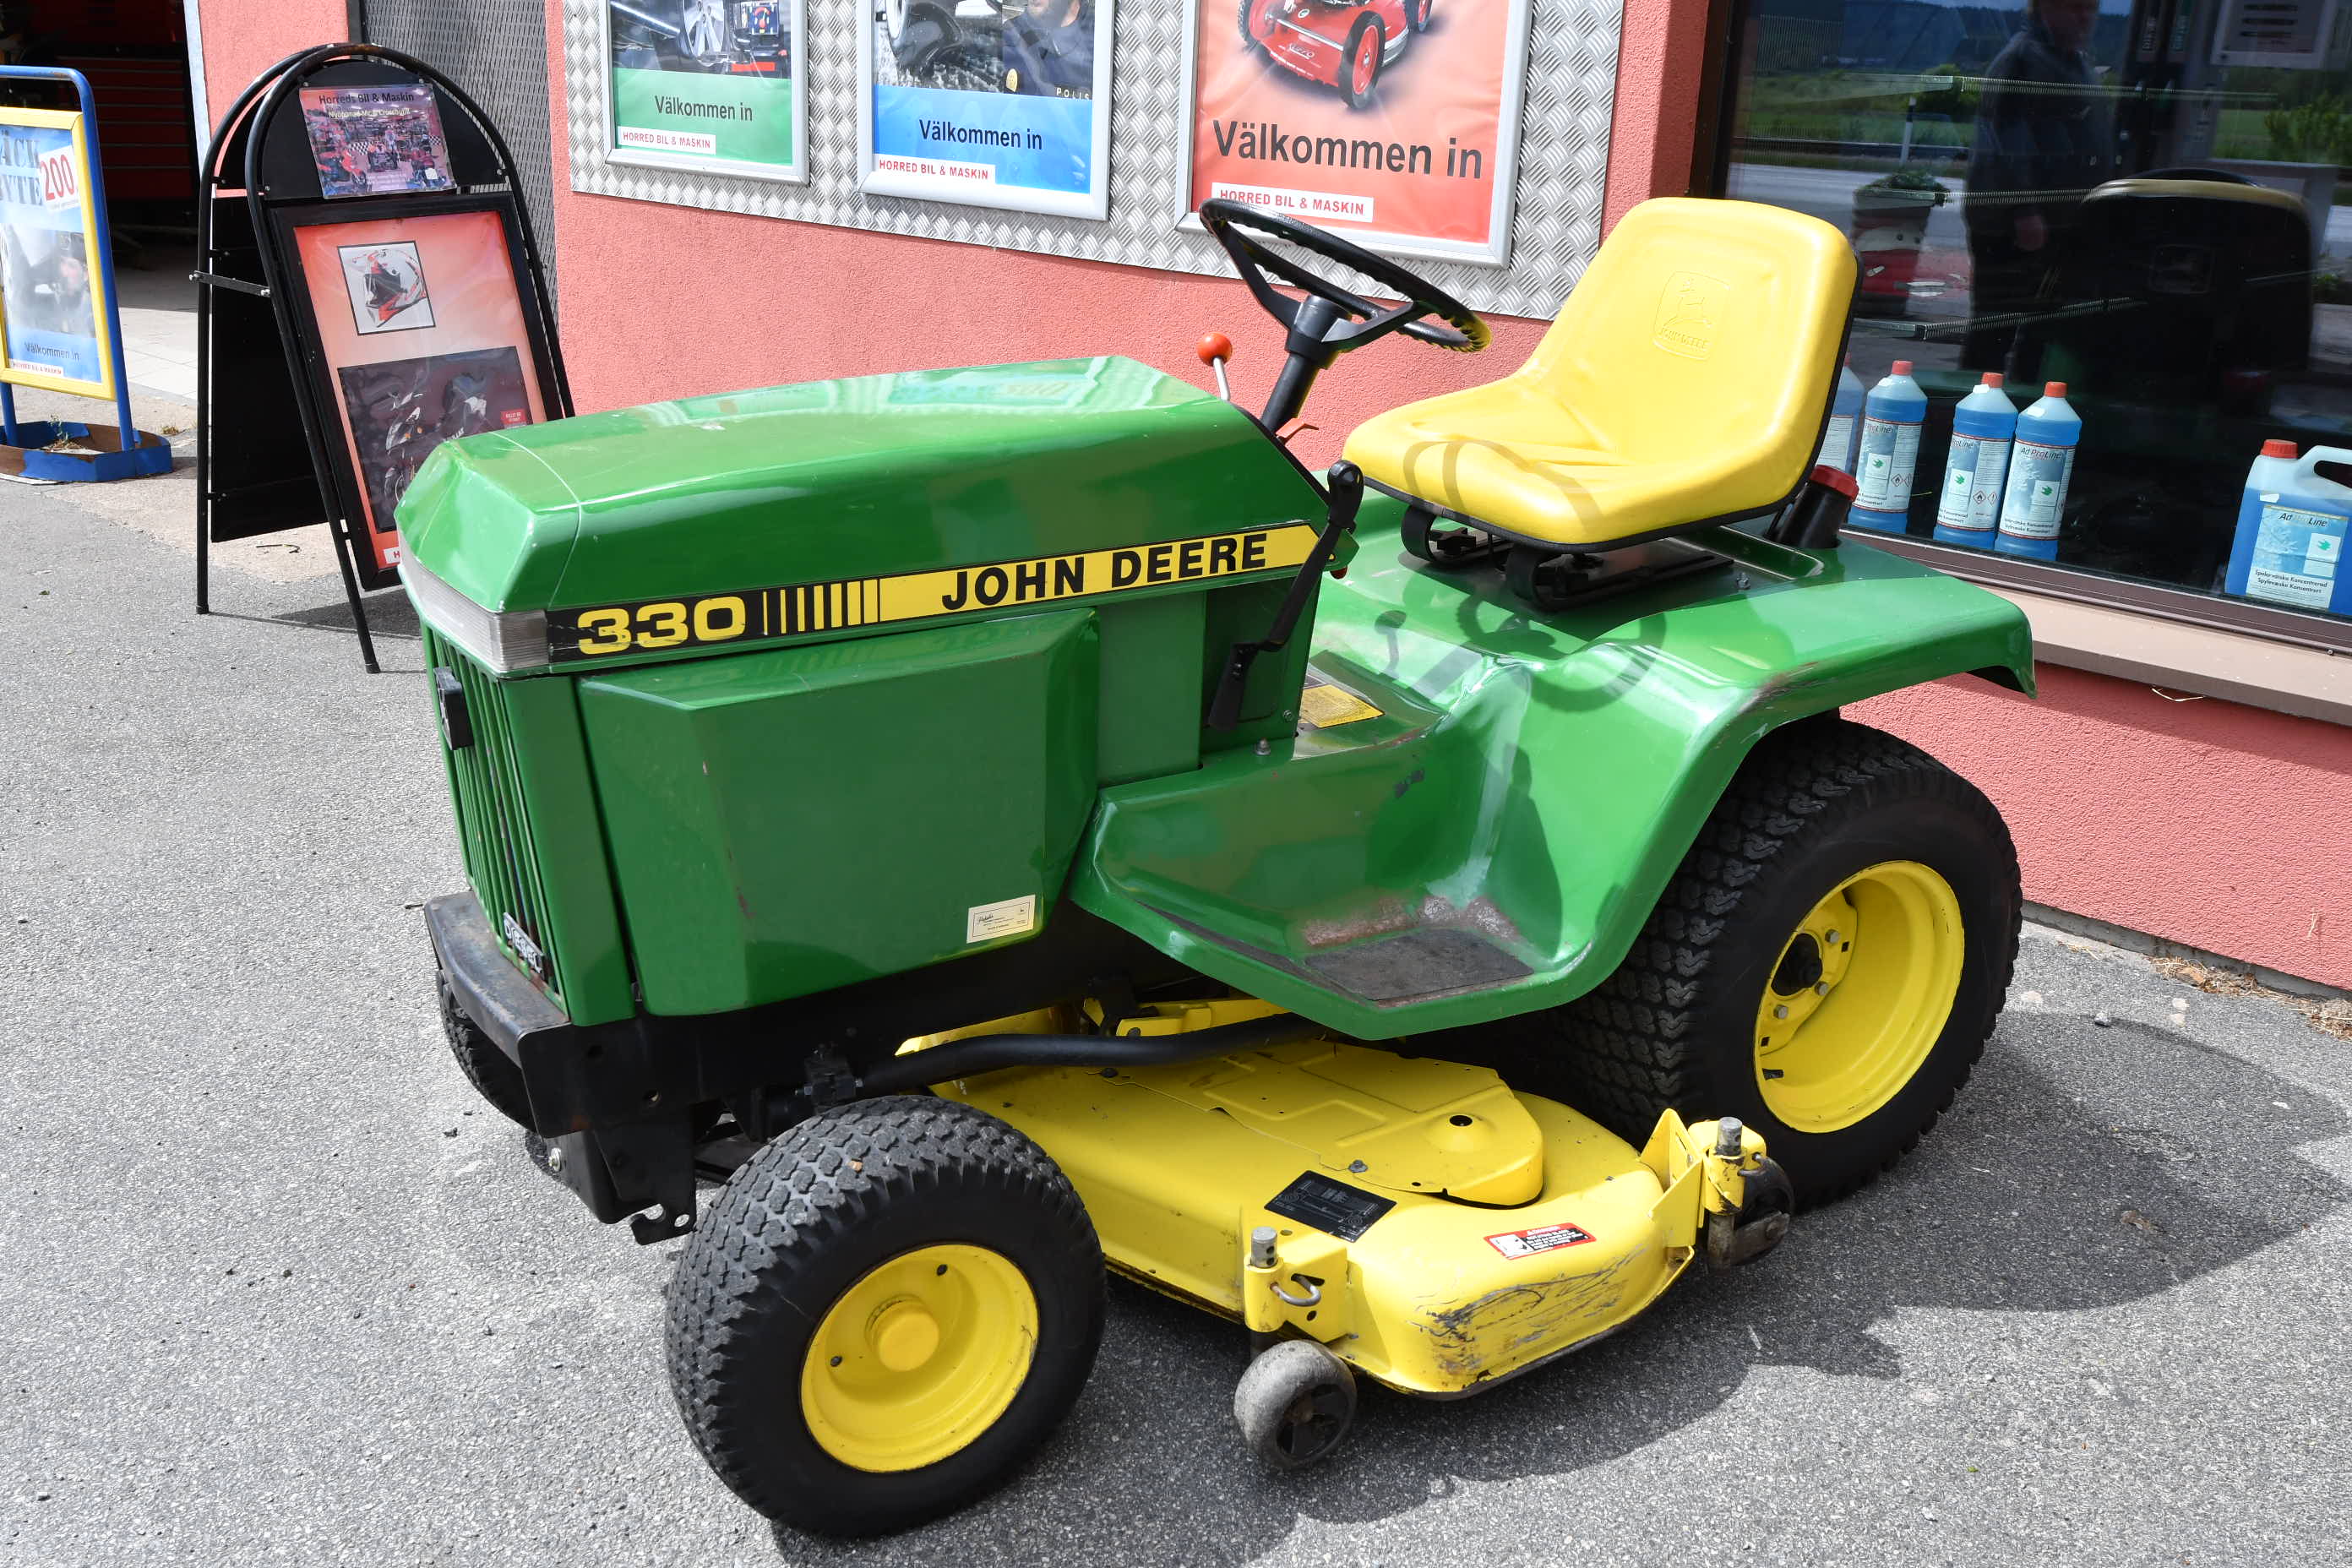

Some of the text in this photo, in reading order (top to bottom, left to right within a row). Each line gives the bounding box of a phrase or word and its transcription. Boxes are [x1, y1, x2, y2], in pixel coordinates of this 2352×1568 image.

[318, 91, 414, 105] Horreds Bil & Maskin
[1056, 87, 1089, 99] POLIS
[654, 95, 754, 122] Välkommen in
[623, 131, 710, 149] HORRED BIL & MASKIN
[918, 118, 1043, 150] Välkommen in
[1212, 119, 1483, 179] Välkommen in
[879, 159, 988, 180] HORRED BIL & MASKIN
[1220, 188, 1364, 215] HORRED BIL & MASKIN
[2021, 446, 2061, 459] Ad ProLine
[2278, 512, 2293, 521] Ad
[941, 532, 1267, 611] JOHN DEERE
[577, 596, 746, 655] 330
